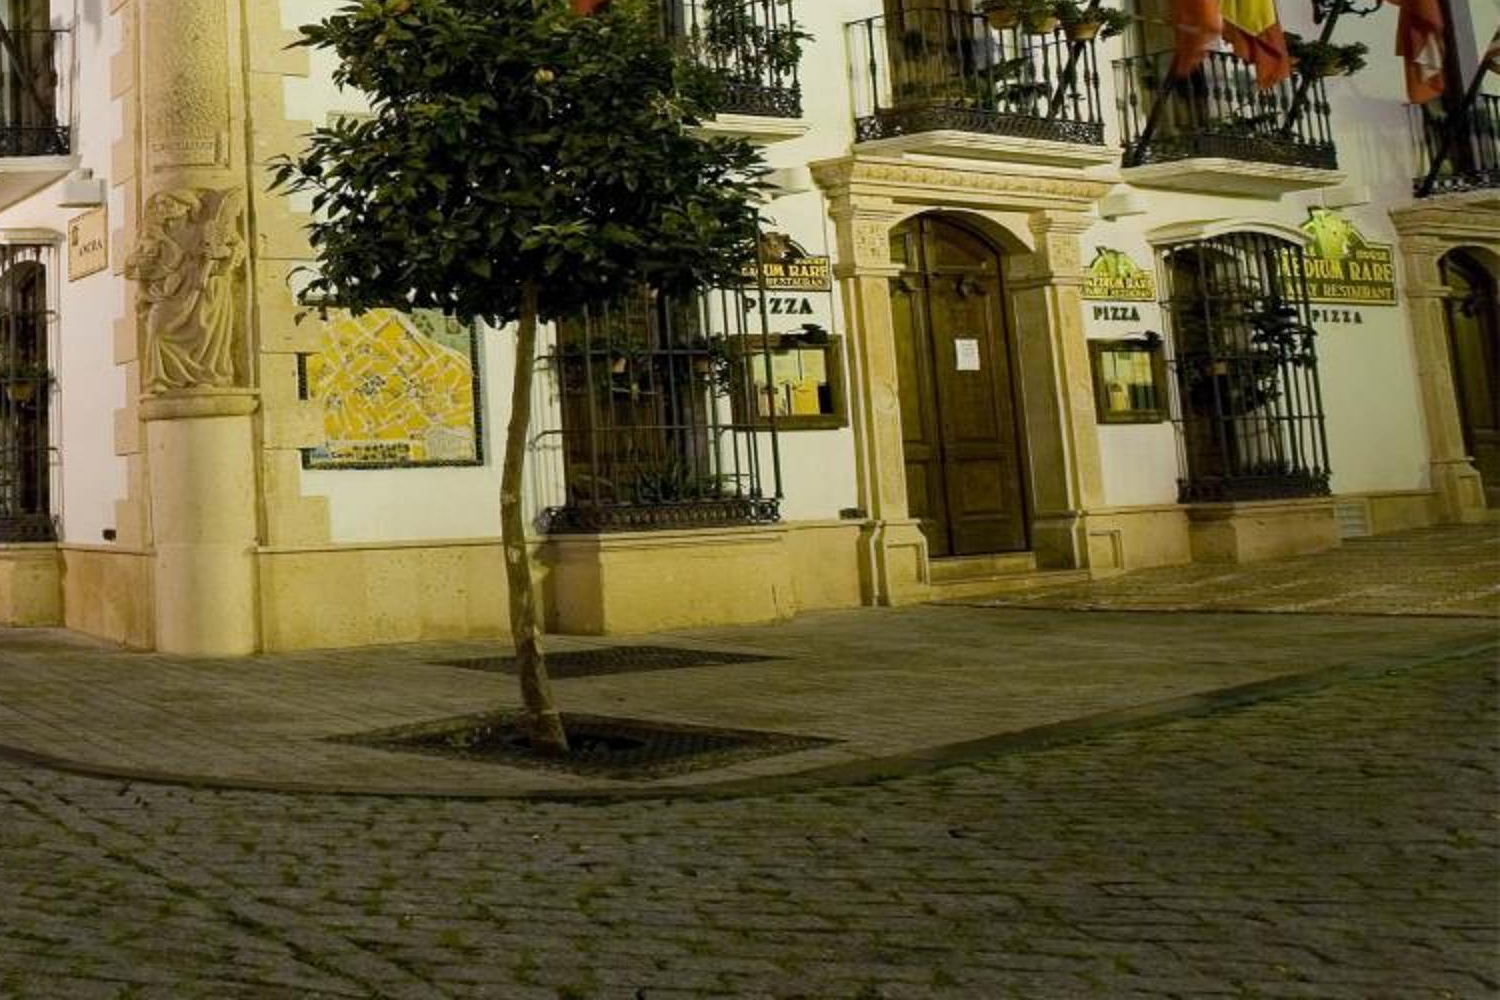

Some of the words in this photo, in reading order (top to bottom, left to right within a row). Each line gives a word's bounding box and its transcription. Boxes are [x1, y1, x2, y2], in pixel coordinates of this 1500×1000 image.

[1349, 262, 1394, 281] RARE
[743, 297, 813, 315] PZZA
[1092, 305, 1141, 321] PIZZA
[1312, 310, 1363, 324] PIZZA
